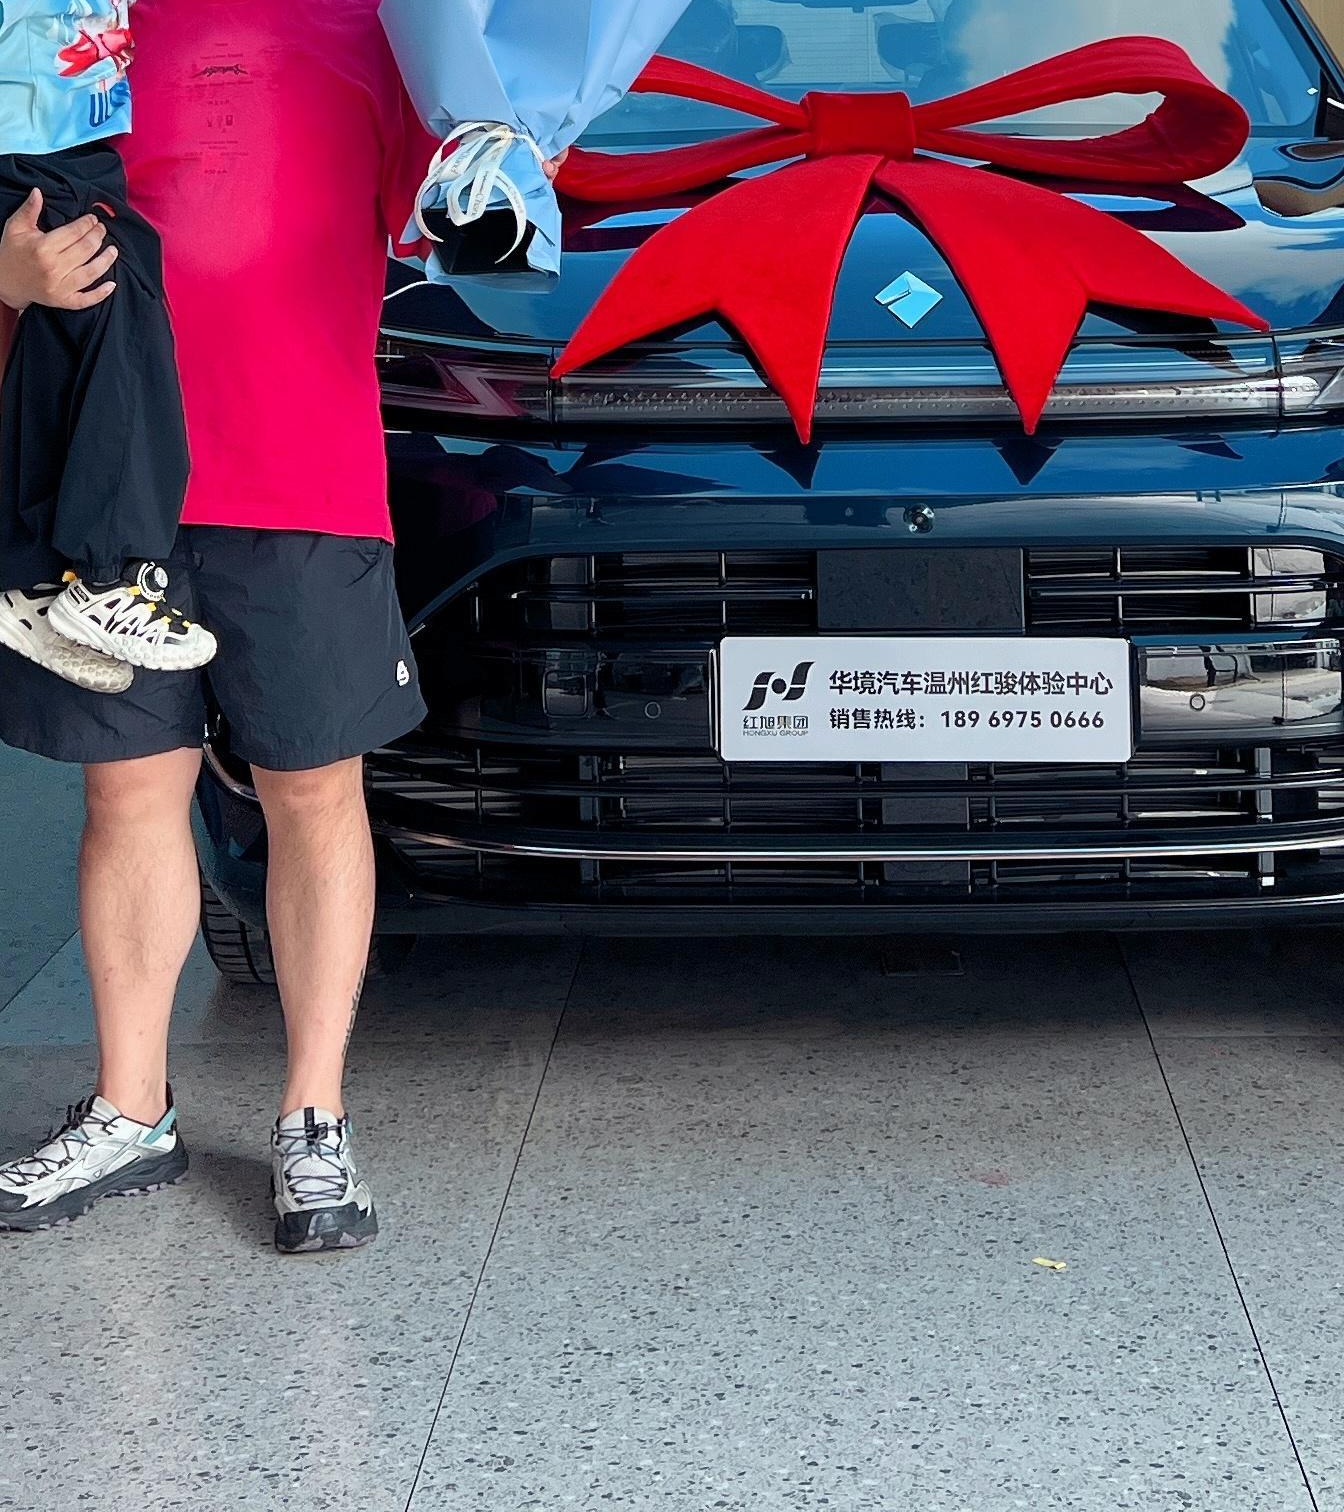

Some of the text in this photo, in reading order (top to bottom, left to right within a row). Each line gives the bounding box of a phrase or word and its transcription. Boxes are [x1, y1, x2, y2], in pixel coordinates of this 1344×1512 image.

[829, 670, 1113, 696] 华境汽车温州红骏体验中心
[940, 710, 980, 728] 189
[988, 710, 1042, 728] 6975
[1050, 710, 1105, 728] 0666
